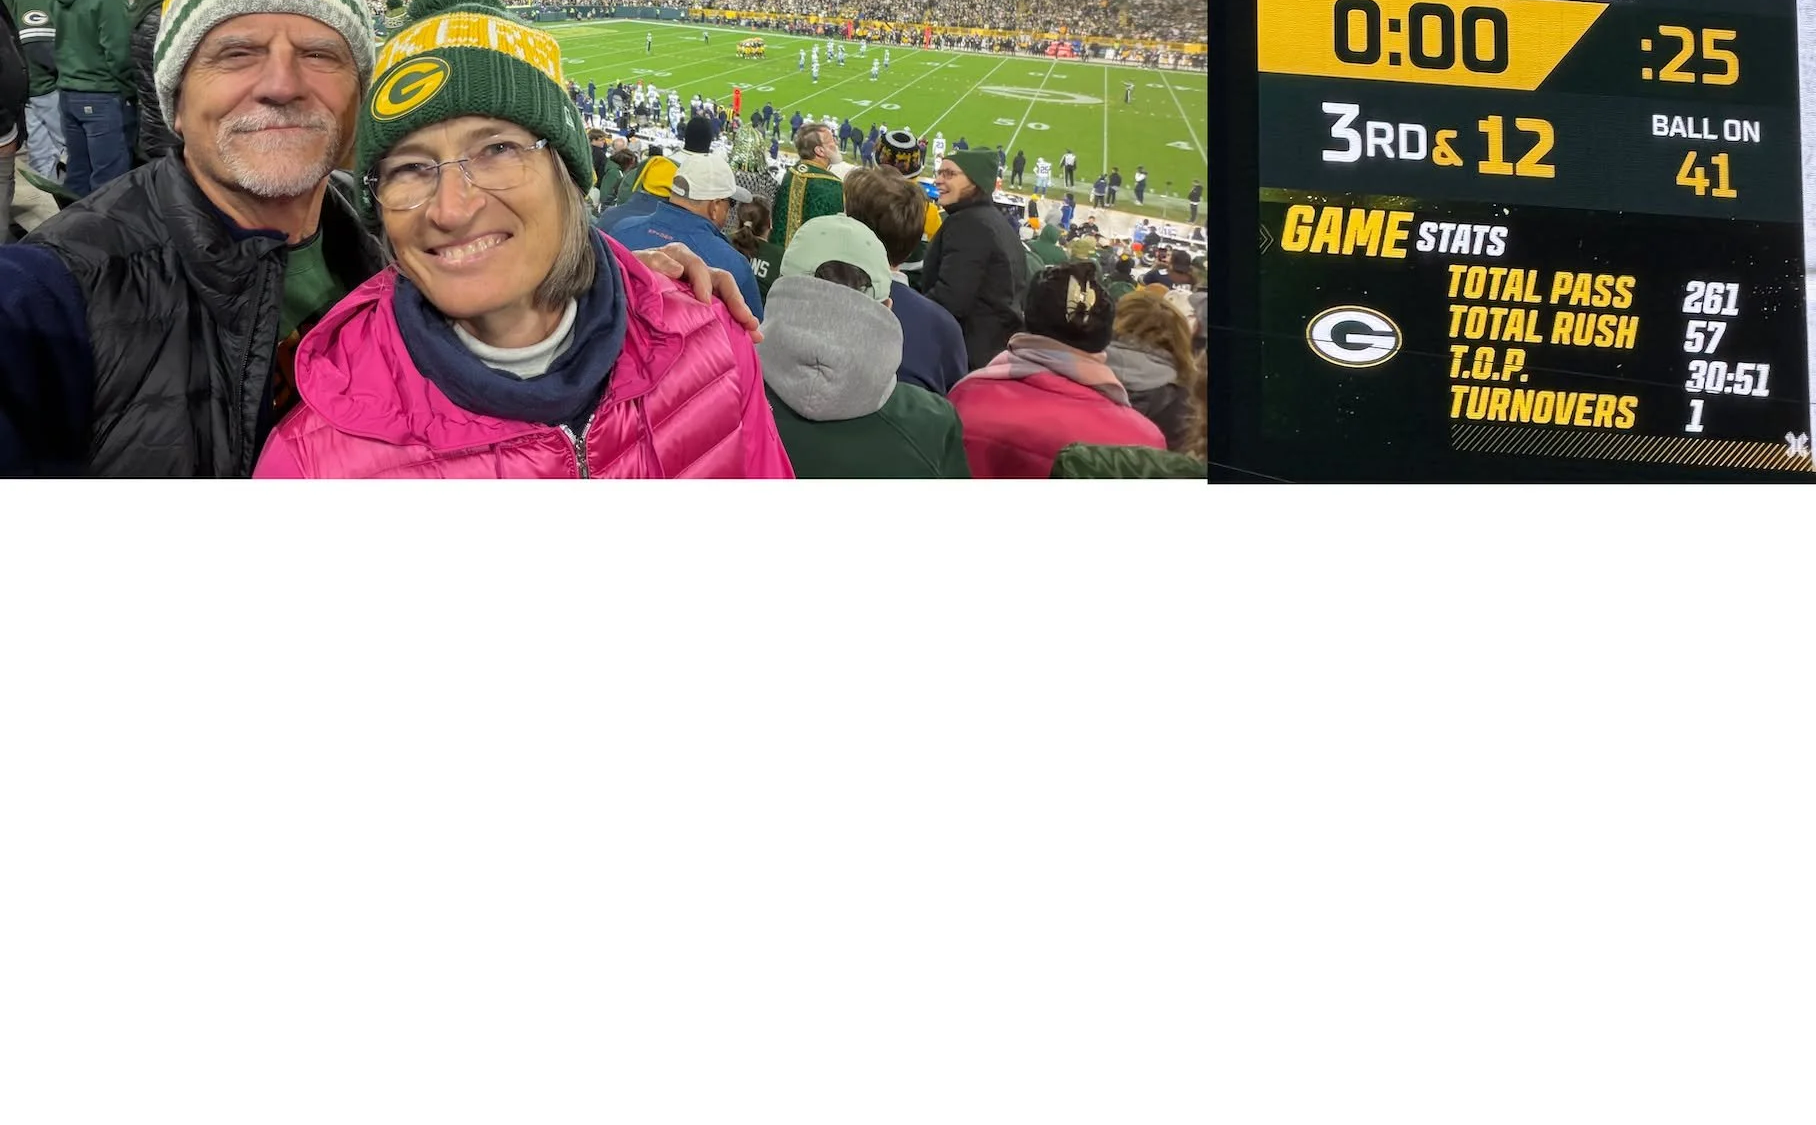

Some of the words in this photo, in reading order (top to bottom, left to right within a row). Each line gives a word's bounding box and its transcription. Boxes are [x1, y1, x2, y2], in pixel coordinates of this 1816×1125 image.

[1640, 24, 1740, 86] :25
[375, 61, 445, 116] G
[993, 117, 1051, 131] 50
[1320, 100, 1428, 163] 3RD
[1477, 114, 1556, 179] 12
[1651, 113, 1718, 141] BALL
[1723, 116, 1761, 144] ON
[1675, 150, 1738, 199] 41
[1280, 203, 1415, 259] GAME
[1415, 220, 1508, 257] STATS
[1446, 263, 1542, 305] TOTAL
[1549, 271, 1637, 310] PASS
[1681, 280, 1740, 317] 261
[1310, 307, 1399, 365] G
[1447, 304, 1543, 345] TOTAL
[1550, 311, 1639, 350] RUSH
[1683, 320, 1725, 355] 57
[1448, 344, 1529, 382] T.O.P.
[1684, 359, 1771, 398] 30:51
[1448, 384, 1639, 430] TURNOVERS
[1684, 399, 1705, 434] 1
